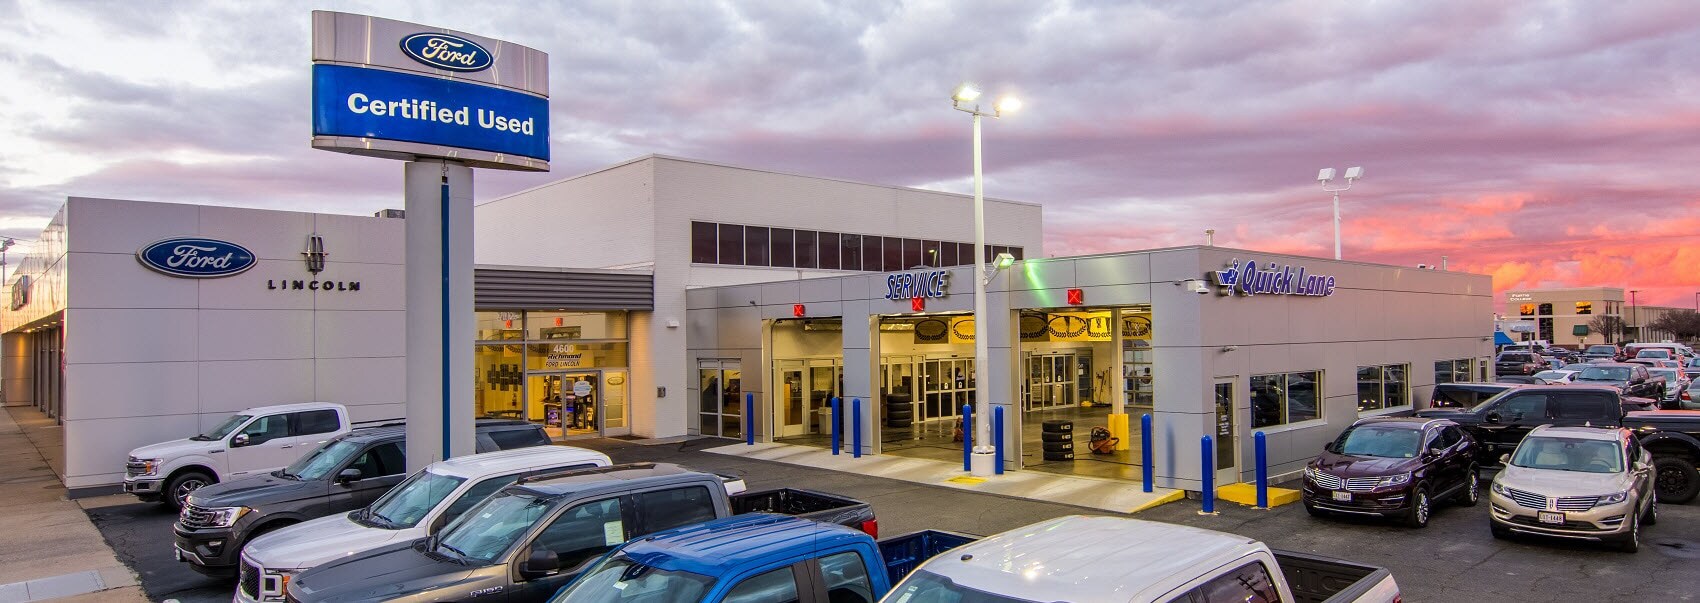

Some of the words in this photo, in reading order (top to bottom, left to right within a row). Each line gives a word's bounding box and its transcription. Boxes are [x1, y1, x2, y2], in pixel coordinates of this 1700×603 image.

[421, 36, 477, 66] Ford
[347, 92, 470, 126] Certified
[478, 110, 534, 136] Used
[166, 244, 234, 269] Ford
[267, 279, 361, 292] LINCOLN
[884, 270, 946, 300] SERVICE
[1241, 260, 1294, 296] Quick
[1295, 266, 1335, 296] Lane
[553, 344, 574, 353] 4600
[546, 360, 559, 368] FORD
[559, 360, 580, 368] LINCOLN
